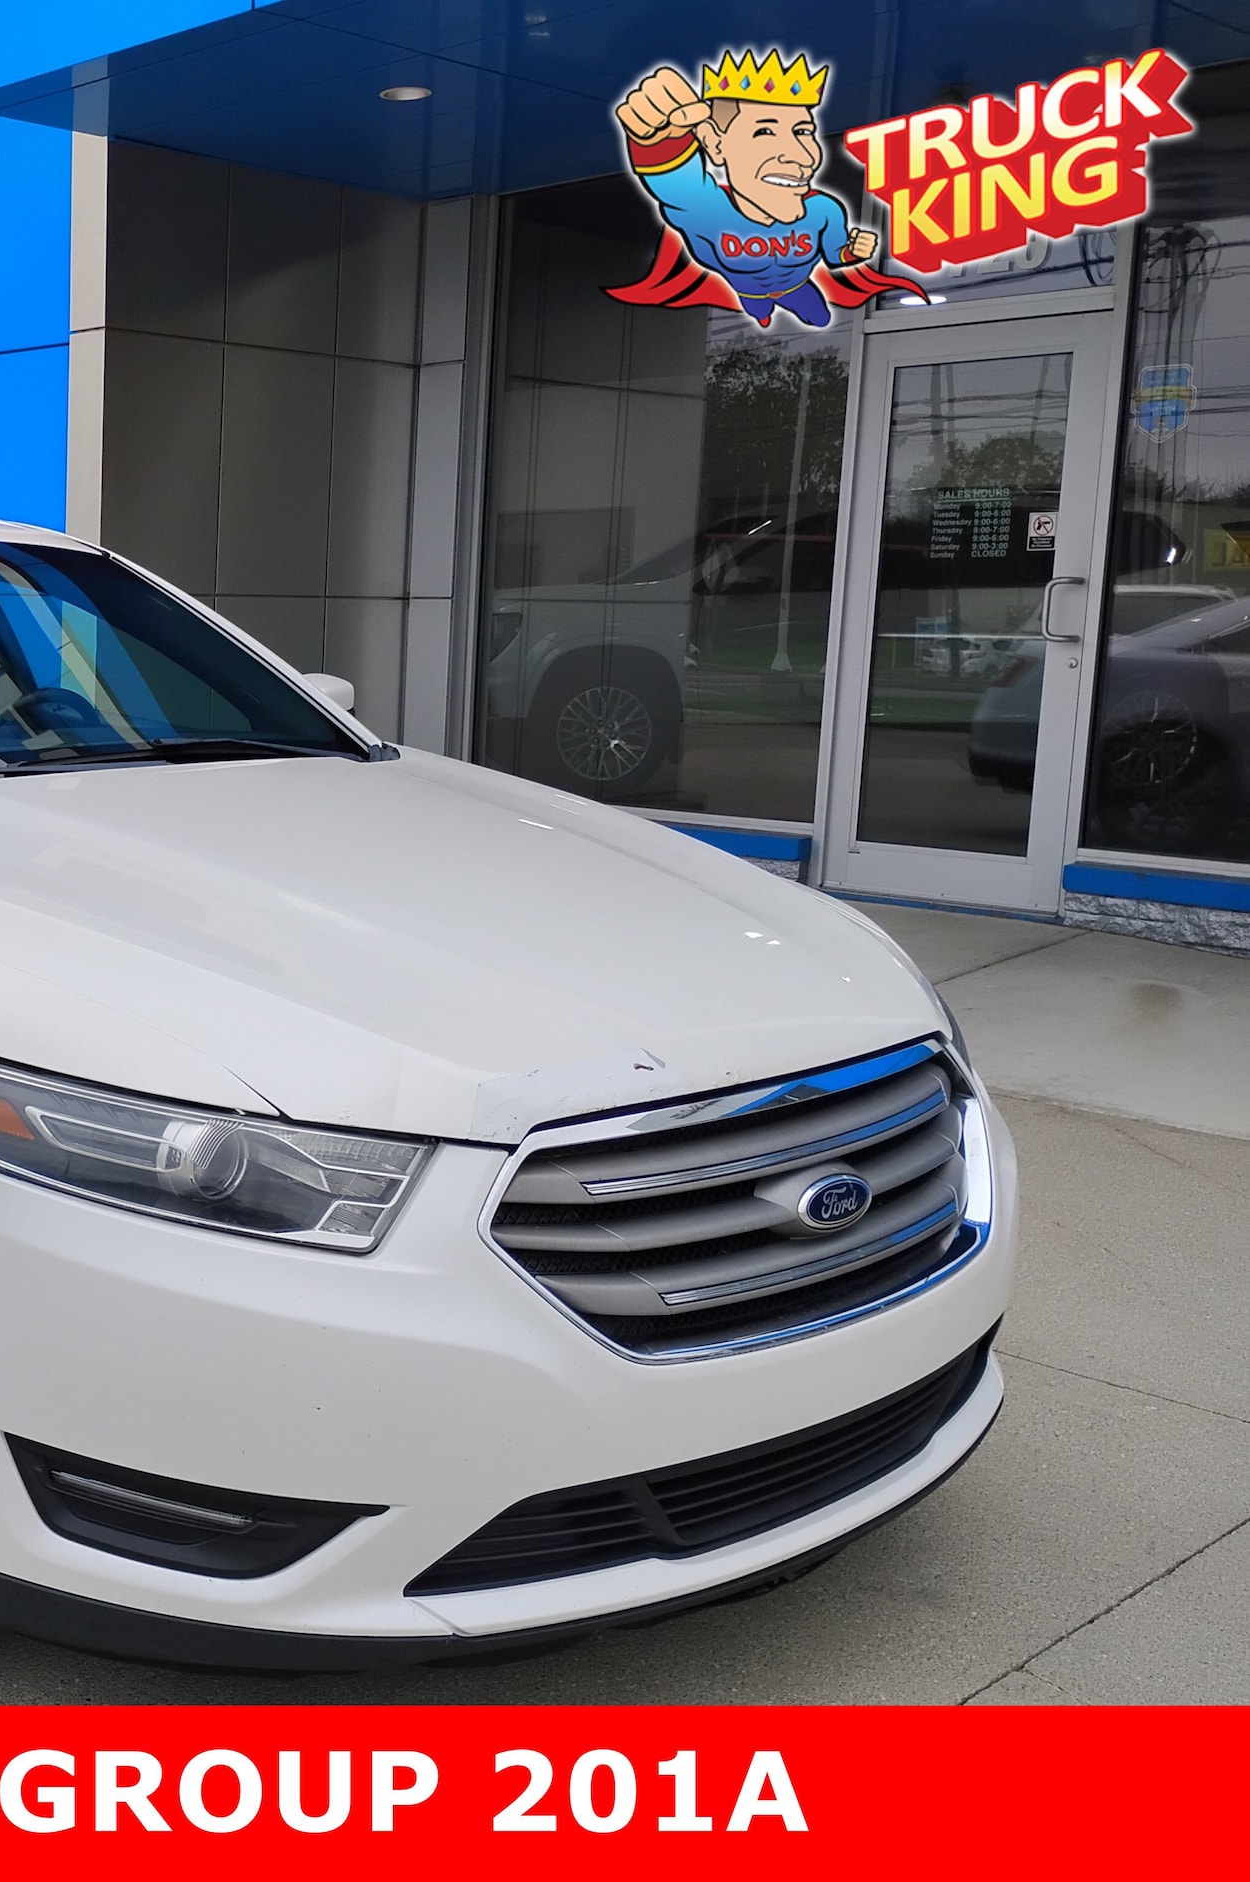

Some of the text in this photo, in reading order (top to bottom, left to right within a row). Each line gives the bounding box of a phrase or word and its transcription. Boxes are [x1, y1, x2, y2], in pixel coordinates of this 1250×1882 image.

[938, 488, 1010, 500] SALES HOURS
[971, 550, 1007, 558] CLOSED
[821, 1186, 858, 1219] Ford
